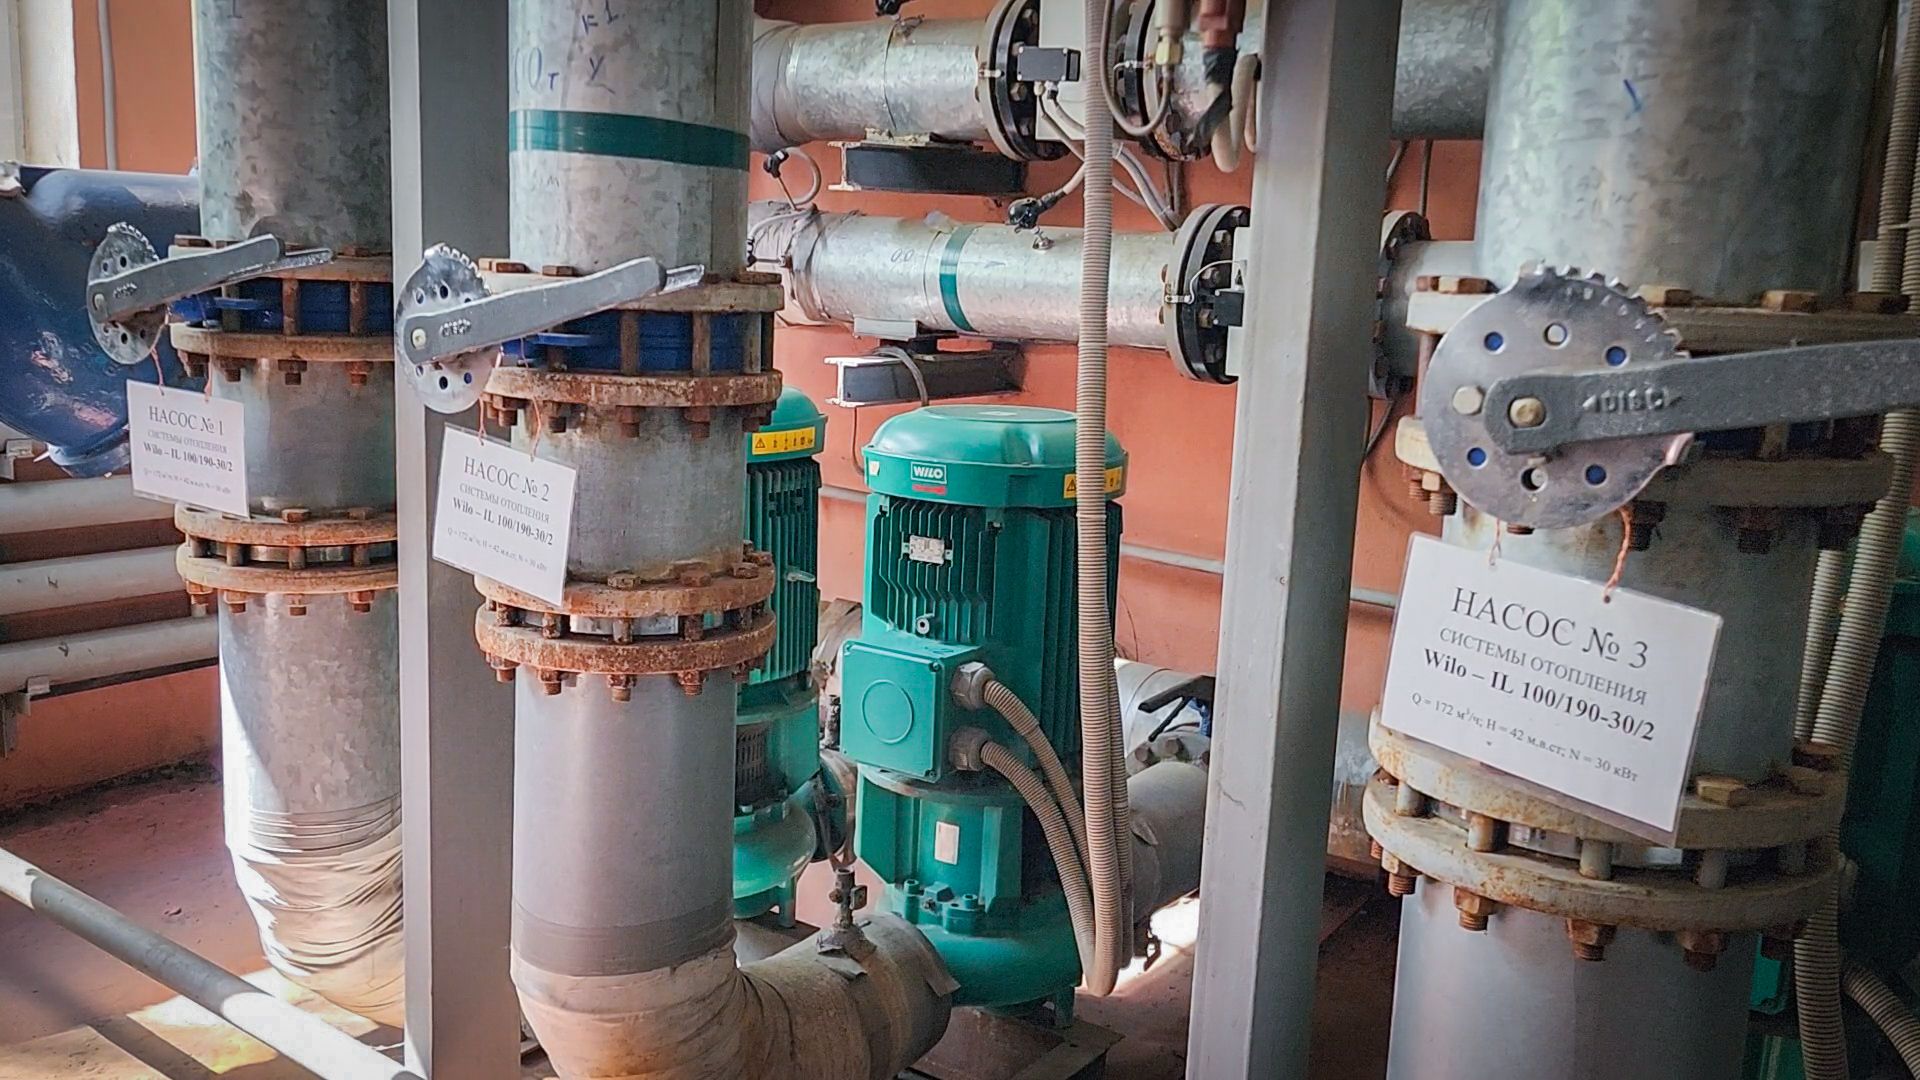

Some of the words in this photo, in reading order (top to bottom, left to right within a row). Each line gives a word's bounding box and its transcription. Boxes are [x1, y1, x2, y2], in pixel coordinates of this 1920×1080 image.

[149, 405, 198, 430] НАСОС
[201, 416, 215, 434] №
[219, 420, 223, 436] 1
[143, 441, 163, 456] Wilo
[171, 447, 182, 460] IL
[913, 465, 943, 479] WILO
[464, 455, 520, 491] НАСОС
[522, 476, 538, 498] №
[541, 483, 550, 502] 2
[452, 497, 474, 516] Wilo
[483, 508, 495, 524] IL
[497, 514, 554, 546] 100/190-30/2
[459, 482, 500, 505] СИСТЕМЫ
[500, 496, 550, 524] ОТОПЛЕНИЯ
[1451, 586, 1576, 647] НАСОС
[1582, 626, 1621, 662] №
[1628, 640, 1648, 669] 3
[1439, 627, 1527, 667] СИСТЕМЫ
[1530, 656, 1648, 706] ОТОПЛЕНИЯ
[1424, 648, 1467, 678] Wilo
[1490, 671, 1514, 695] IL
[1521, 681, 1655, 742] 100/190-30/2
[1412, 692, 1422, 706] Q
[1435, 700, 1454, 716] 172
[1509, 727, 1525, 741] 42
[1568, 748, 1581, 761] N
[1594, 757, 1611, 773] 30
[1613, 765, 1639, 782] кВт
